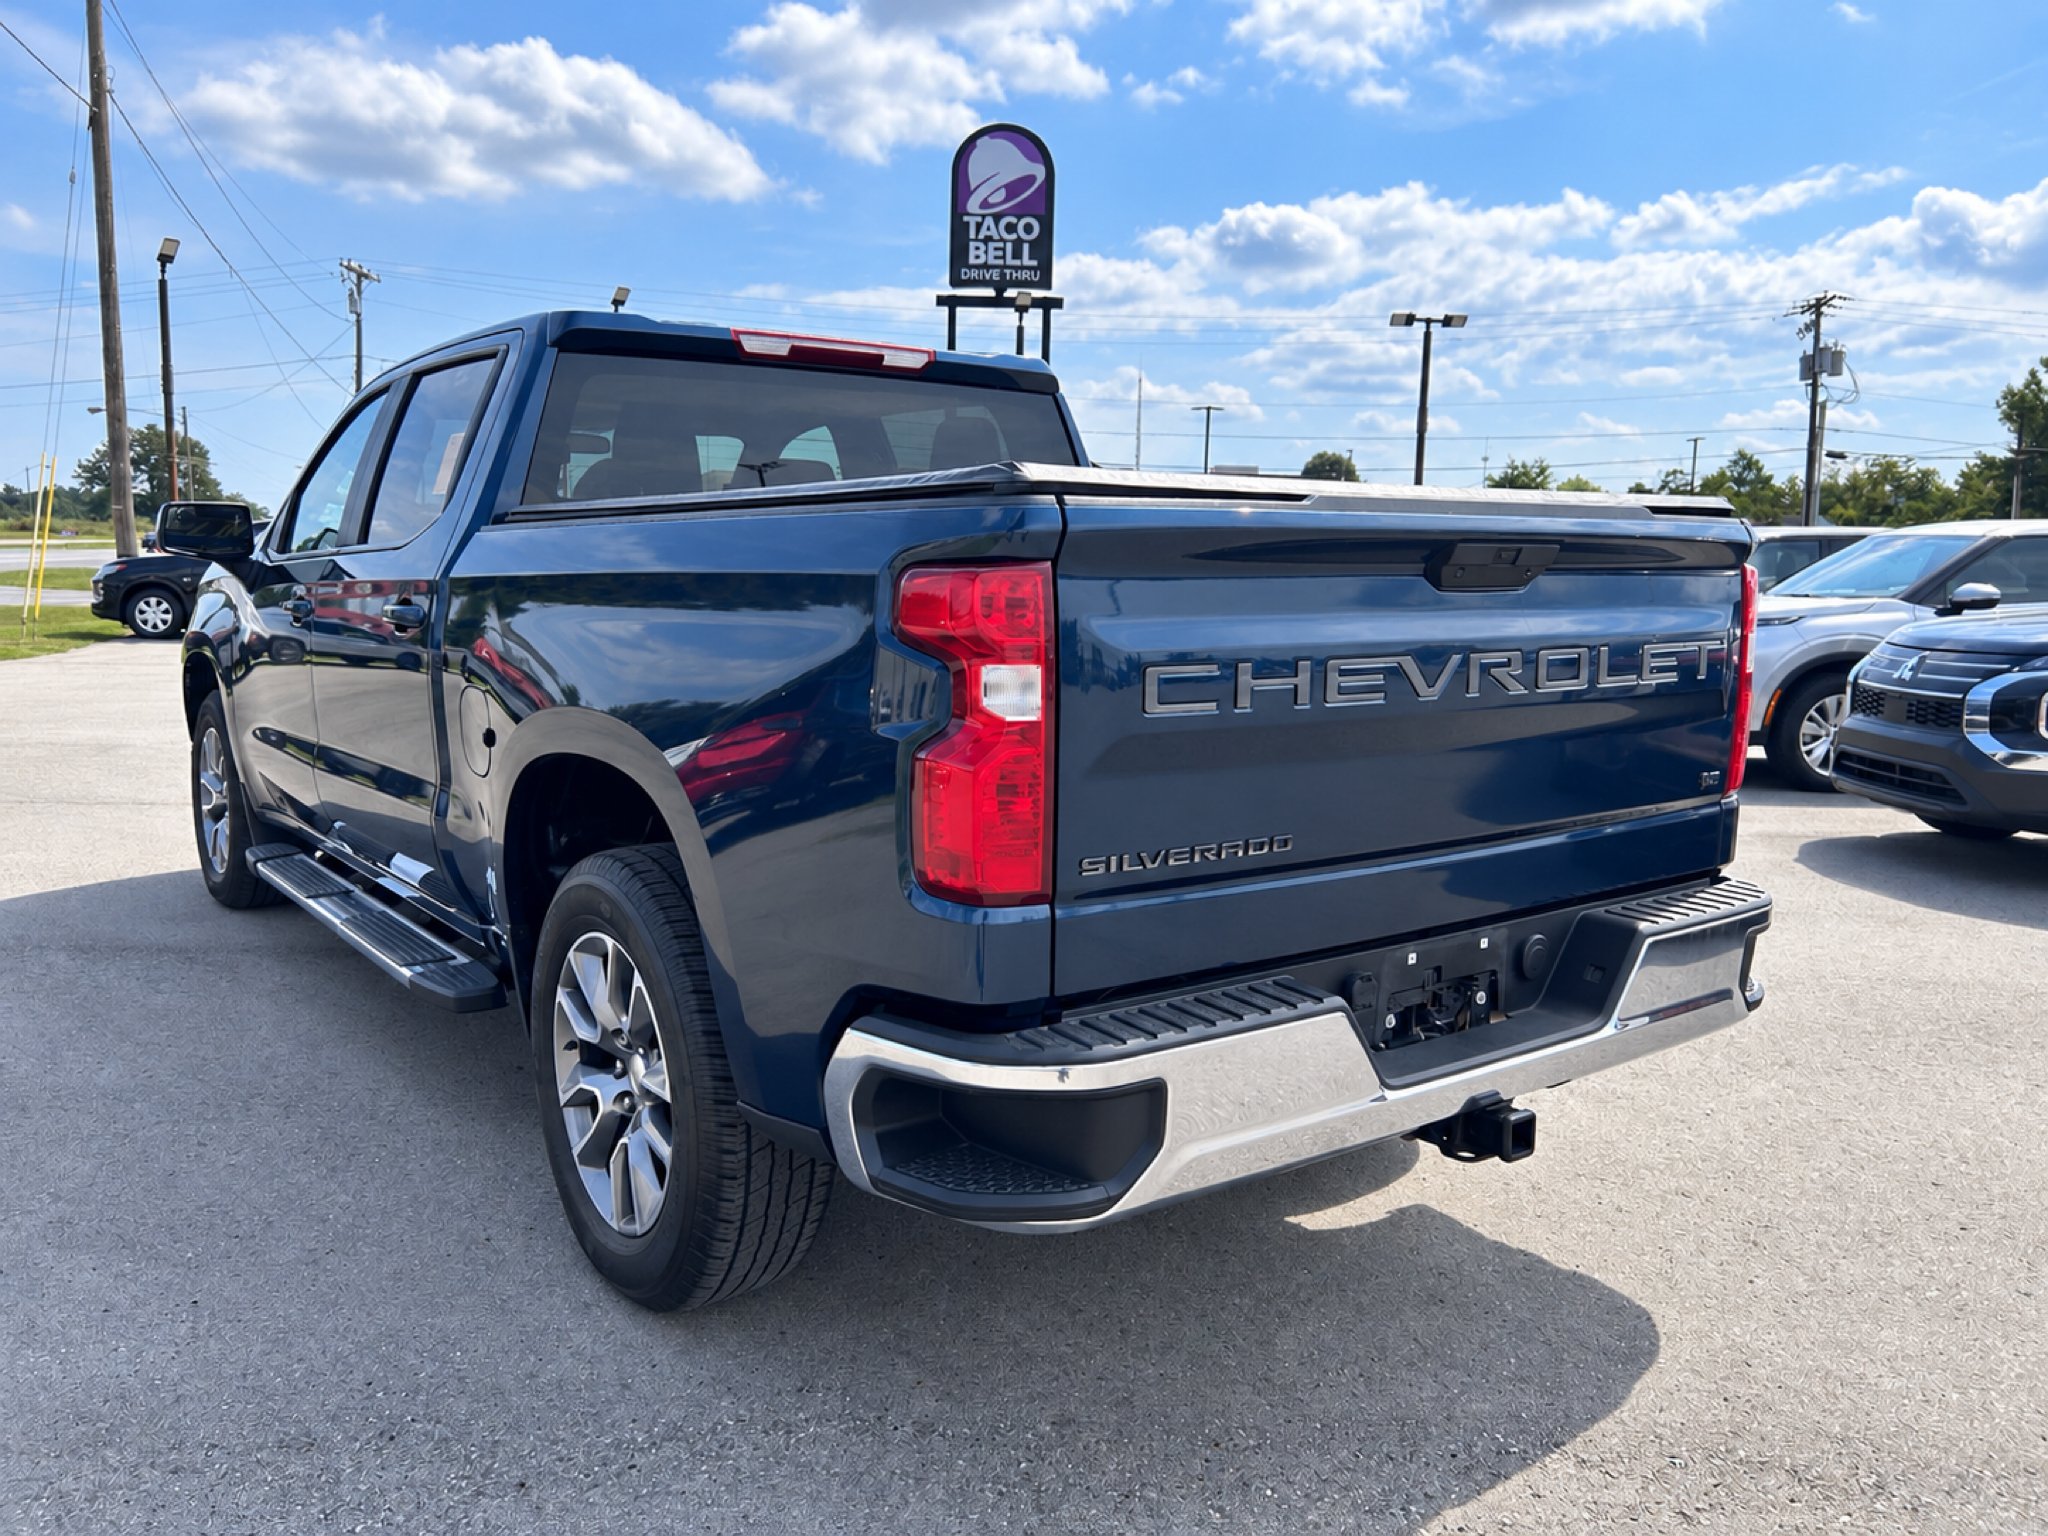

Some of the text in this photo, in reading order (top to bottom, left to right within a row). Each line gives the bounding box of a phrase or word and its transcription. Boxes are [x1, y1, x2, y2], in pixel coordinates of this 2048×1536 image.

[962, 215, 1041, 241] TACO
[968, 242, 1039, 267] BELL
[961, 268, 1041, 281] DRIVE THRU
[1142, 639, 1726, 717] CHEVROLET
[1080, 834, 1293, 876] SILVERADO
